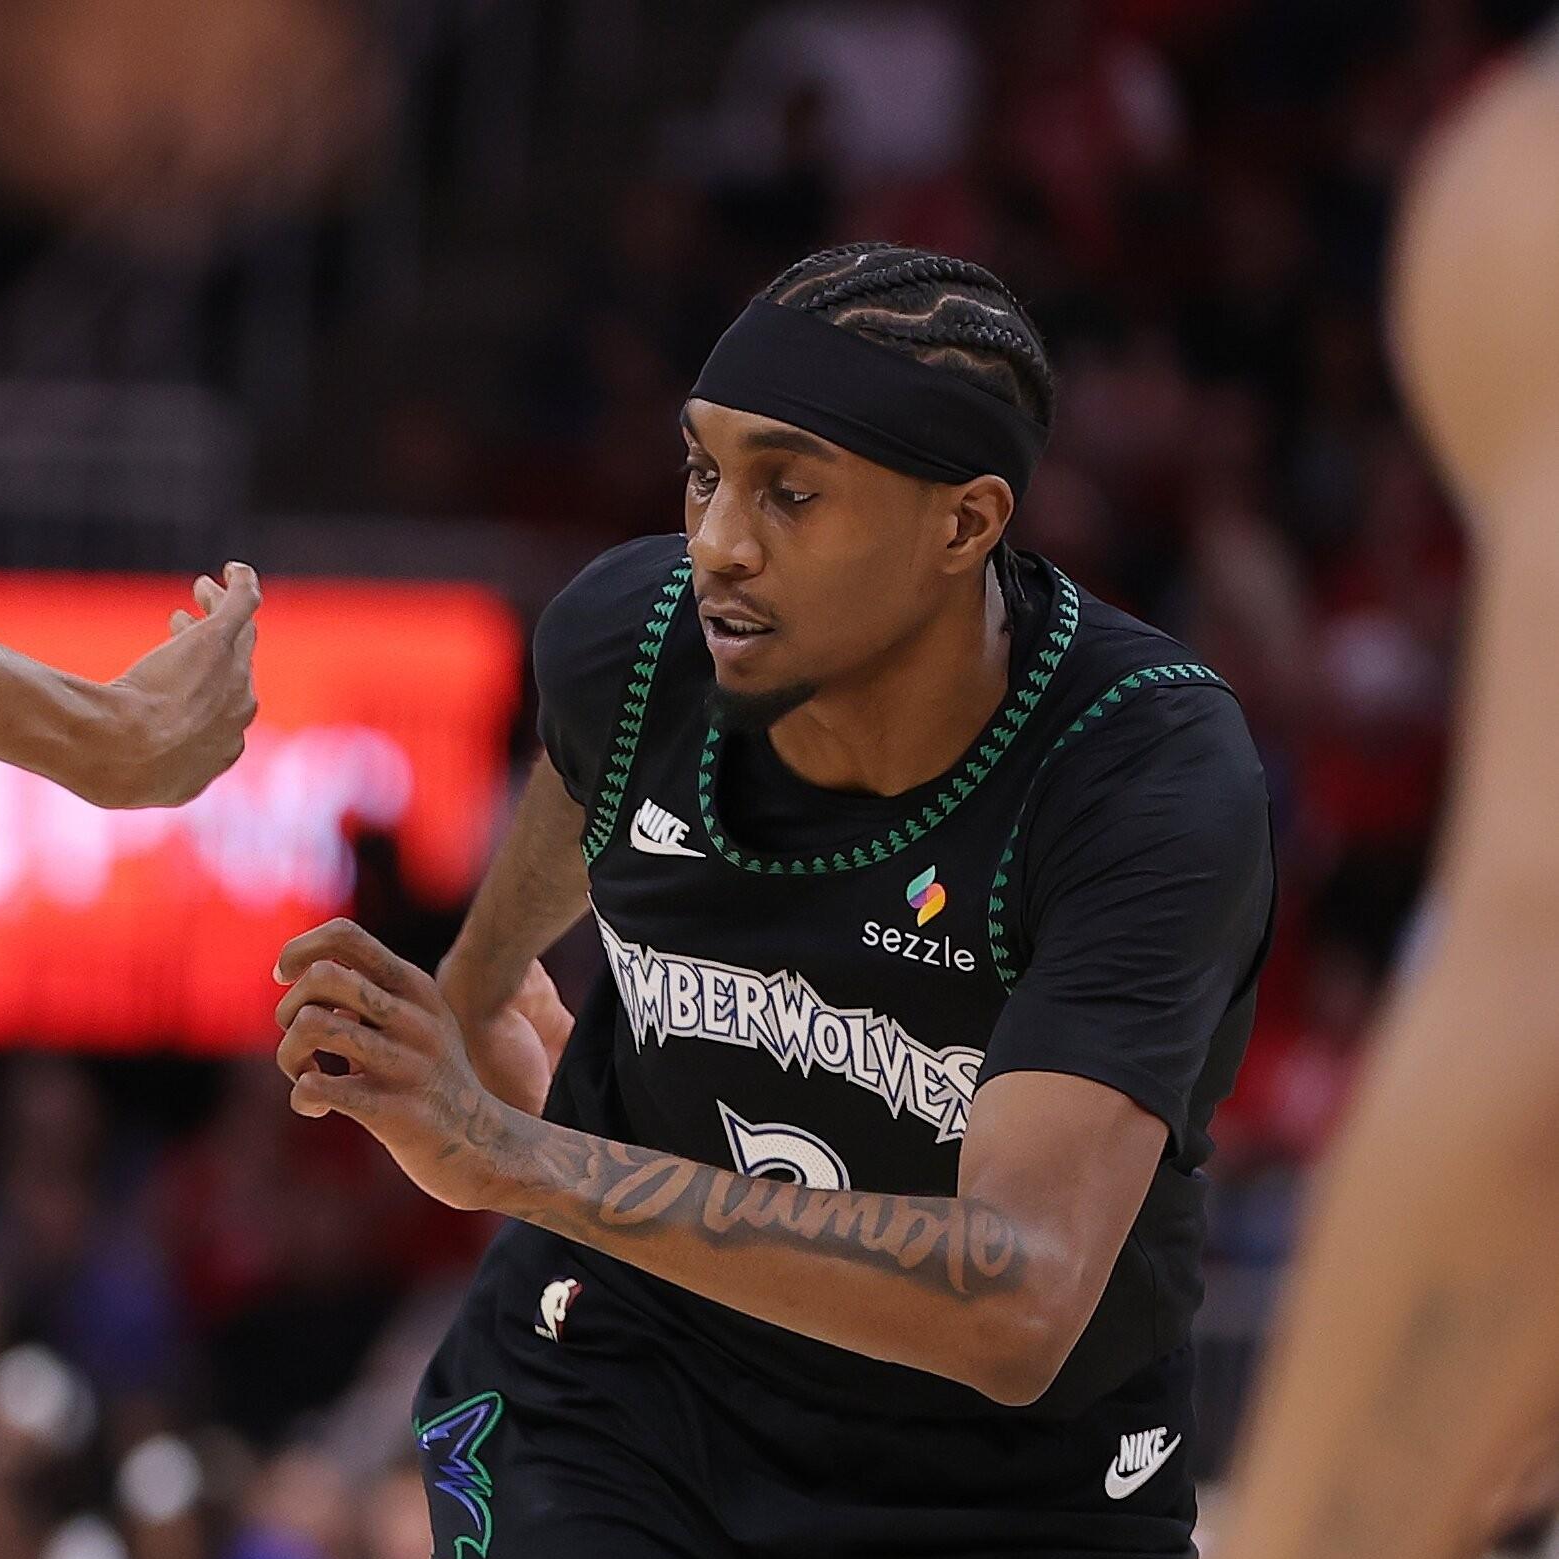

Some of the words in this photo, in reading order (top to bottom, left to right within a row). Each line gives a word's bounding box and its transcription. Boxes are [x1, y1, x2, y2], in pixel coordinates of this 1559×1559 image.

[637, 797, 690, 846] NIKE
[861, 919, 976, 972] sezzle
[1118, 1426, 1168, 1473] NIKE
